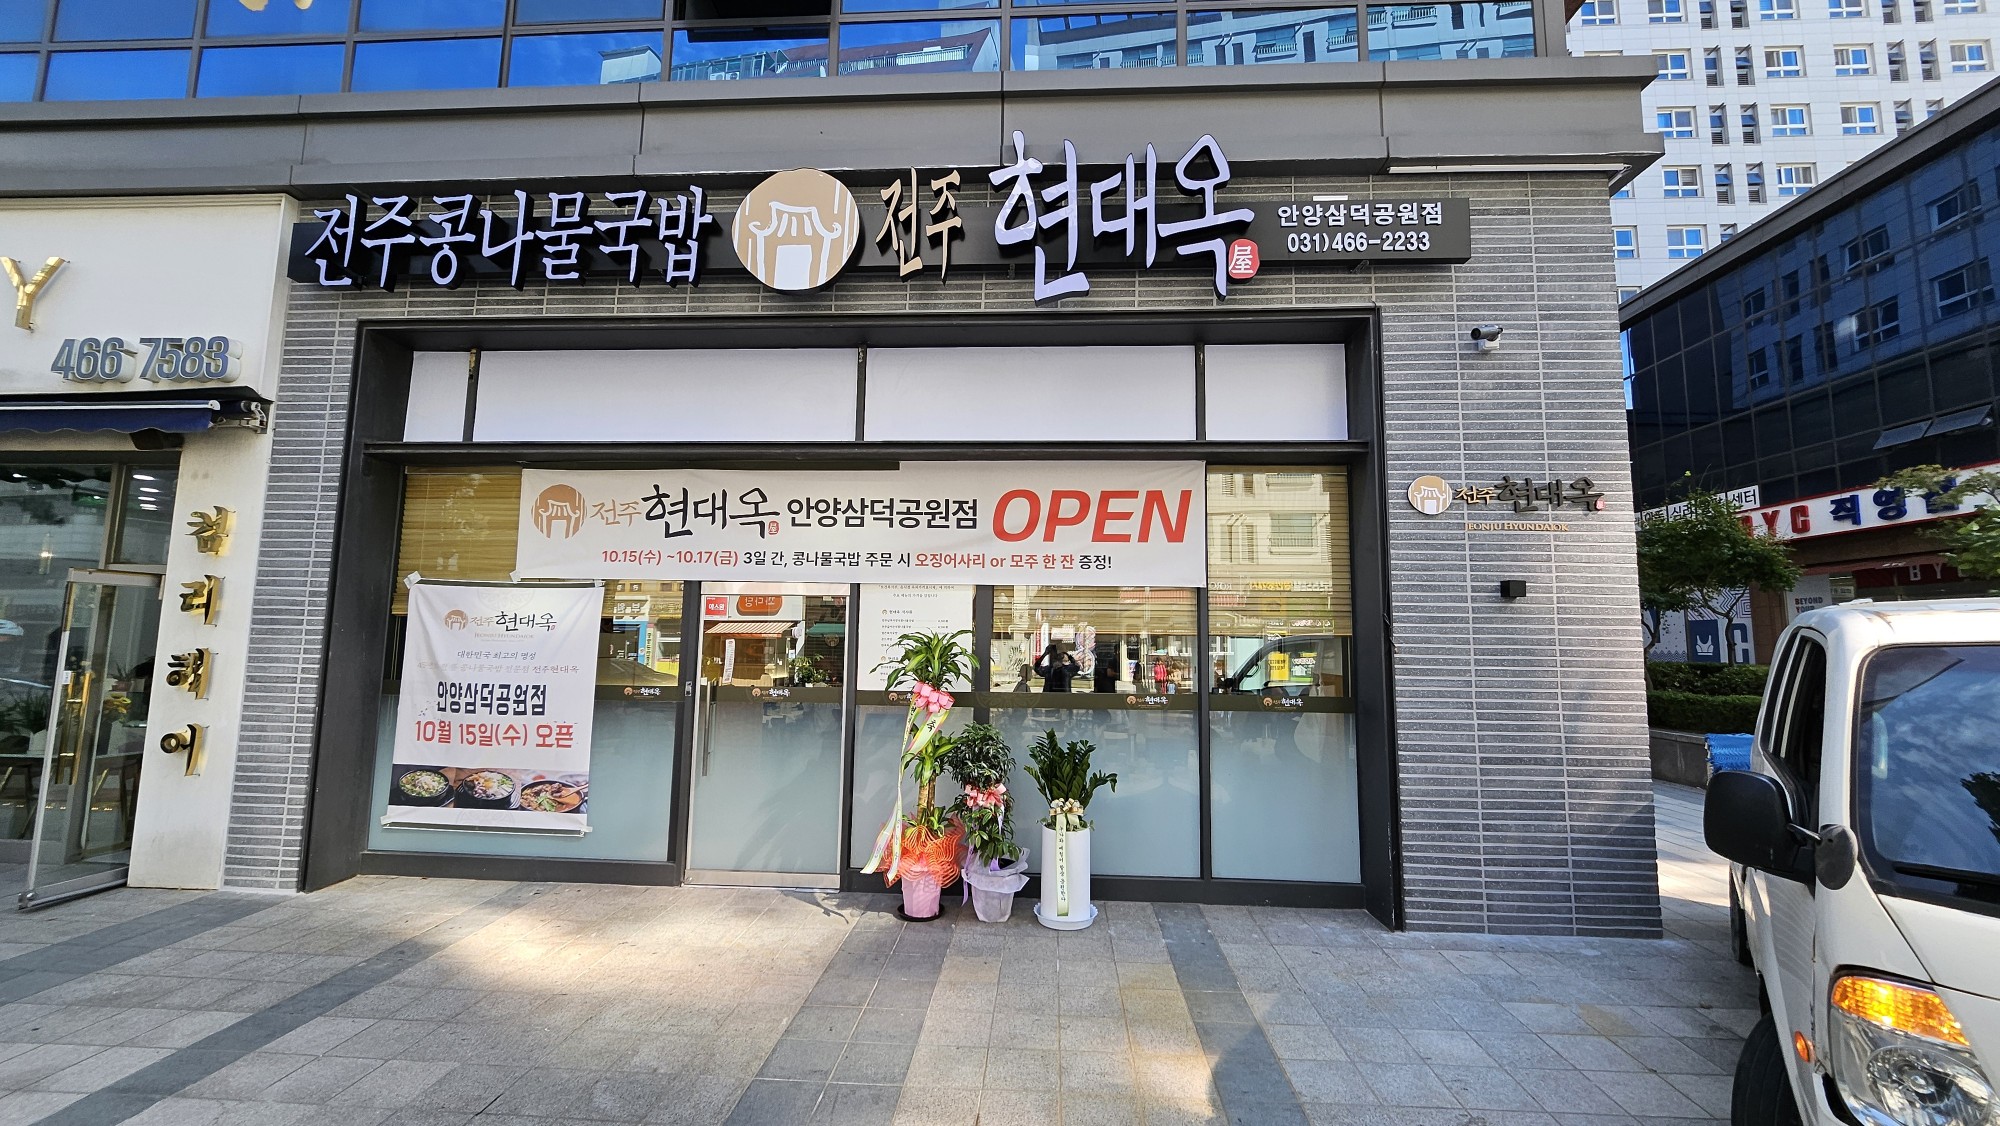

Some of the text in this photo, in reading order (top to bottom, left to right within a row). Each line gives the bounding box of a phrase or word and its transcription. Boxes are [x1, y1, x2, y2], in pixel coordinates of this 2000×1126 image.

[876, 130, 1255, 300] 전주 현대옥
[1277, 202, 1443, 227] 안양삼덕공원점
[305, 185, 713, 287] 전주콩나물국밥
[1287, 231, 1431, 252] 031)466-2233
[50, 335, 232, 382] 466 7583
[1454, 485, 1497, 505] 전주
[1494, 476, 1605, 514] 현대옥
[589, 483, 780, 539] 전주 현대옥
[787, 497, 978, 529] 안양삼덕공원점
[992, 488, 1193, 543] OPEN
[1465, 522, 1501, 531] JEONJU
[601, 550, 662, 566] 10.15(수)
[743, 551, 766, 566] 3일
[770, 551, 788, 568] 간,
[791, 551, 861, 567] 콩나물국밥
[864, 552, 894, 567] 주문
[897, 552, 911, 567] 시
[914, 553, 986, 569] 오징어사리
[989, 556, 1006, 568] or
[1009, 554, 1038, 569] 모주
[1042, 554, 1056, 569] 한
[1060, 554, 1075, 569] 잔
[1078, 554, 1112, 569] 증정!
[1794, 596, 1823, 605] BEYOND
[494, 611, 557, 631] 현대옥
[457, 650, 491, 660] 대한민국
[437, 681, 547, 716] 안양삼덕공원점
[415, 720, 574, 748] 10월 15일(수) 오픈
